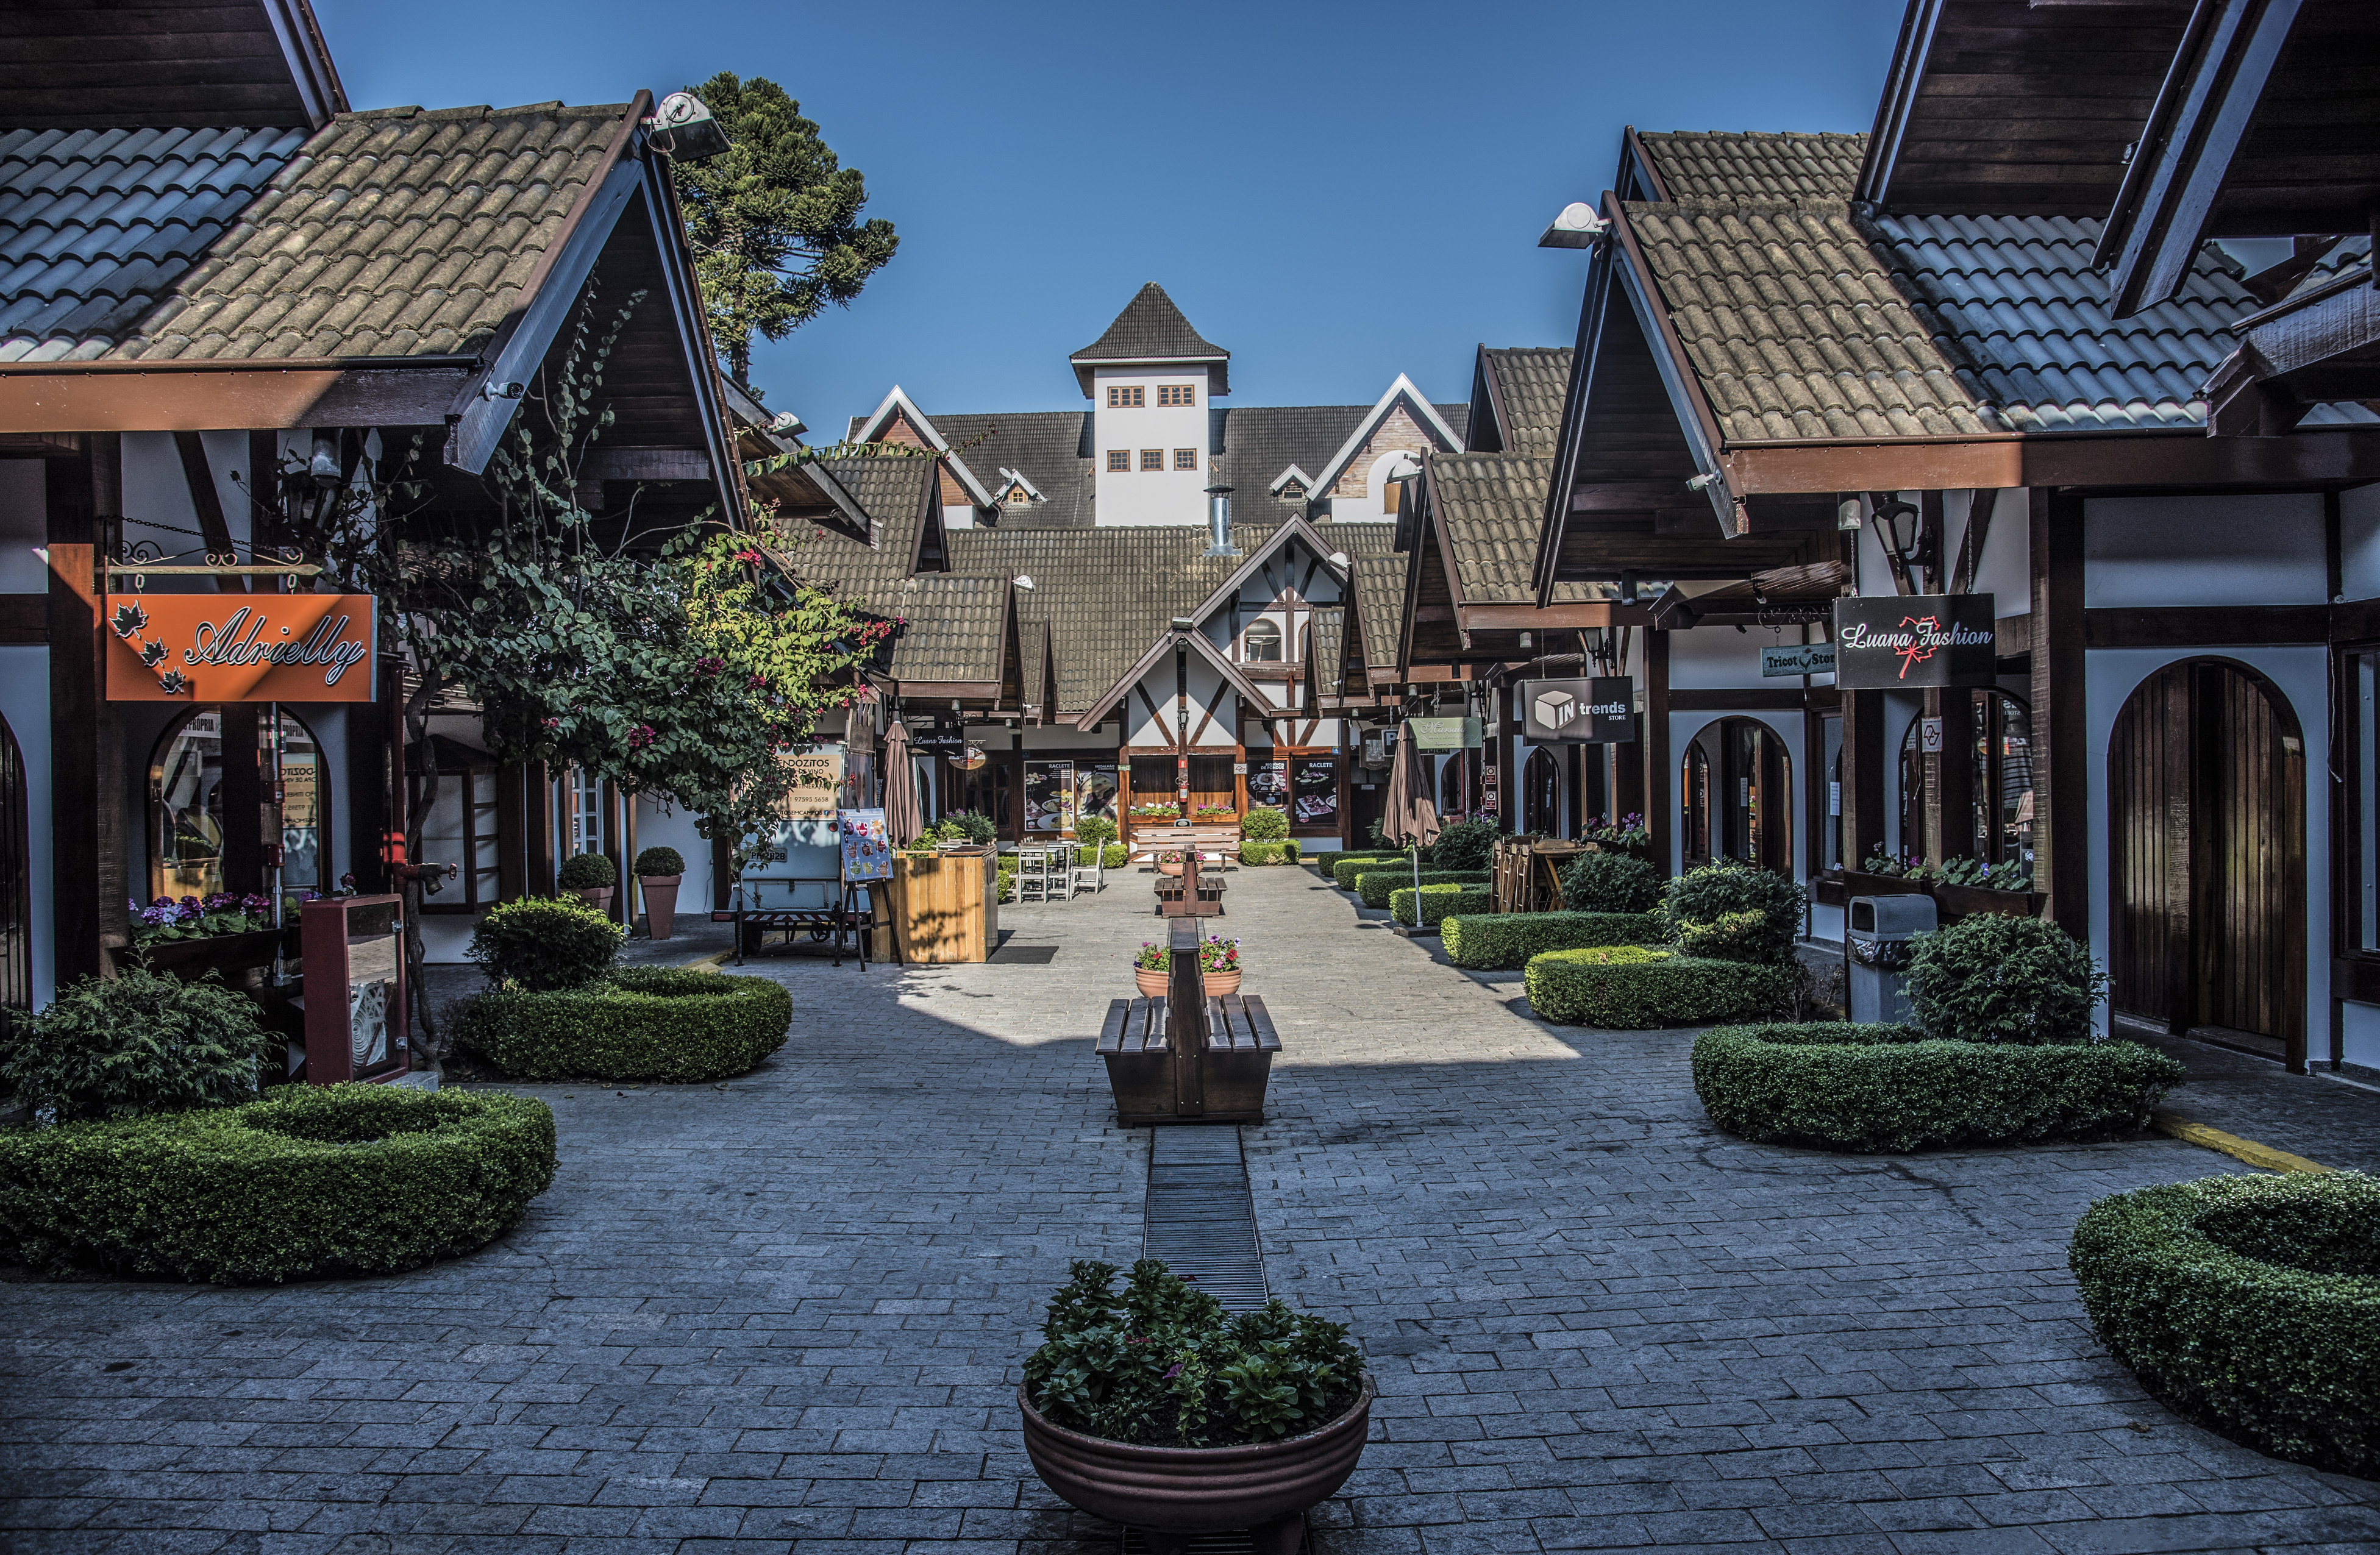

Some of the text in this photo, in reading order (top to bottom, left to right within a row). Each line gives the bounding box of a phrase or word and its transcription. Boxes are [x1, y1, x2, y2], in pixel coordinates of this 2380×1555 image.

[1840, 621, 1993, 649] Luana Fashion
[183, 607, 366, 685] Adrielly
[1767, 655, 1797, 669] Tricot
[1579, 702, 1626, 715] trends
[282, 723, 304, 738] PRÓPRIA
[1420, 721, 1467, 735] Marsala
[914, 736, 963, 745] Luana Fashion
